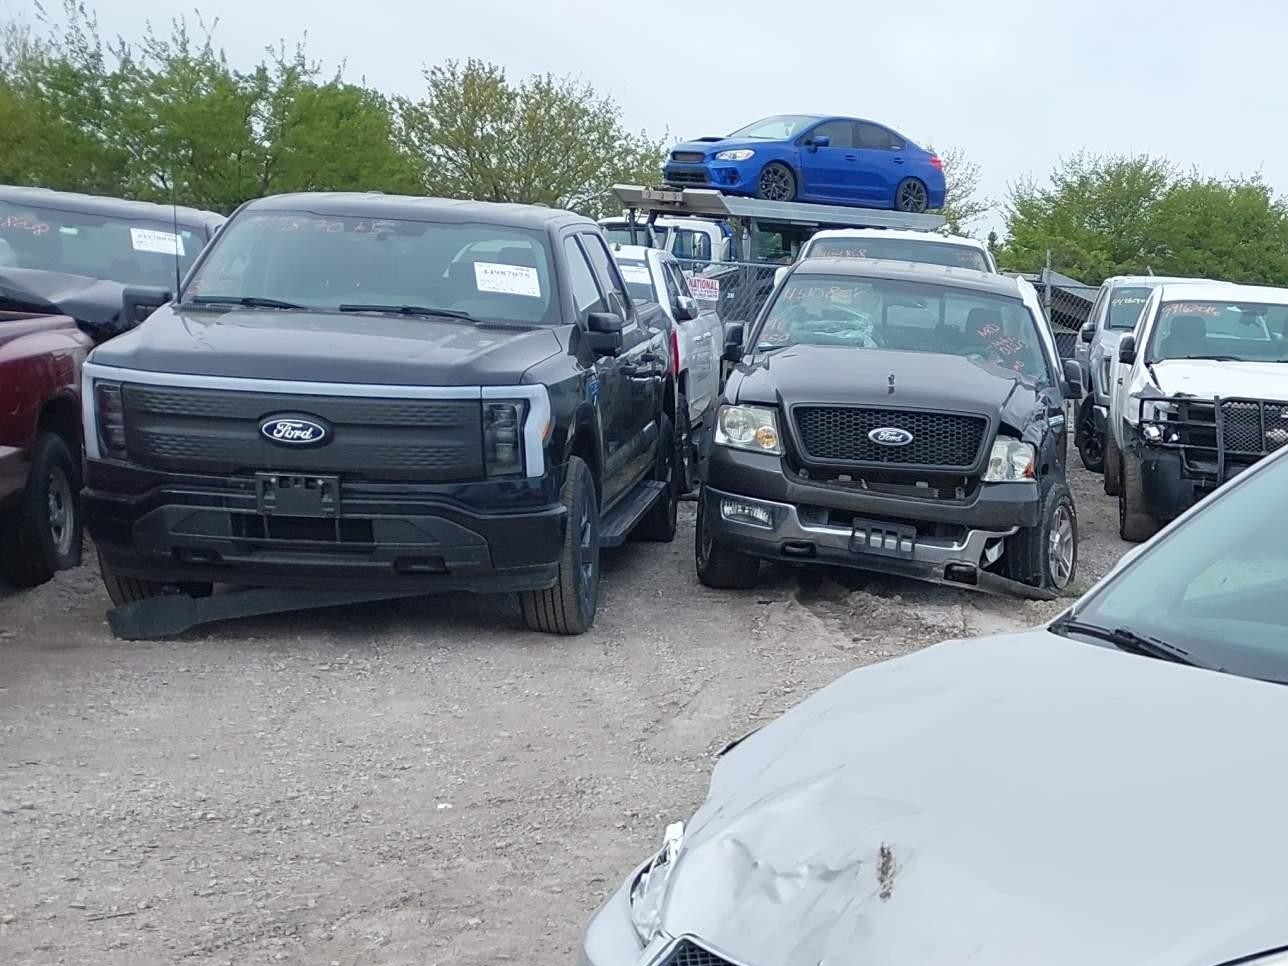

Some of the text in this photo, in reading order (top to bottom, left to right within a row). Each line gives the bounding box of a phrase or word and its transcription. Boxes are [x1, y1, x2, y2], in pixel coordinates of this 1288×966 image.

[687, 278, 718, 291] NATIONAL
[273, 421, 313, 440] Ford
[878, 431, 904, 442] Ford
